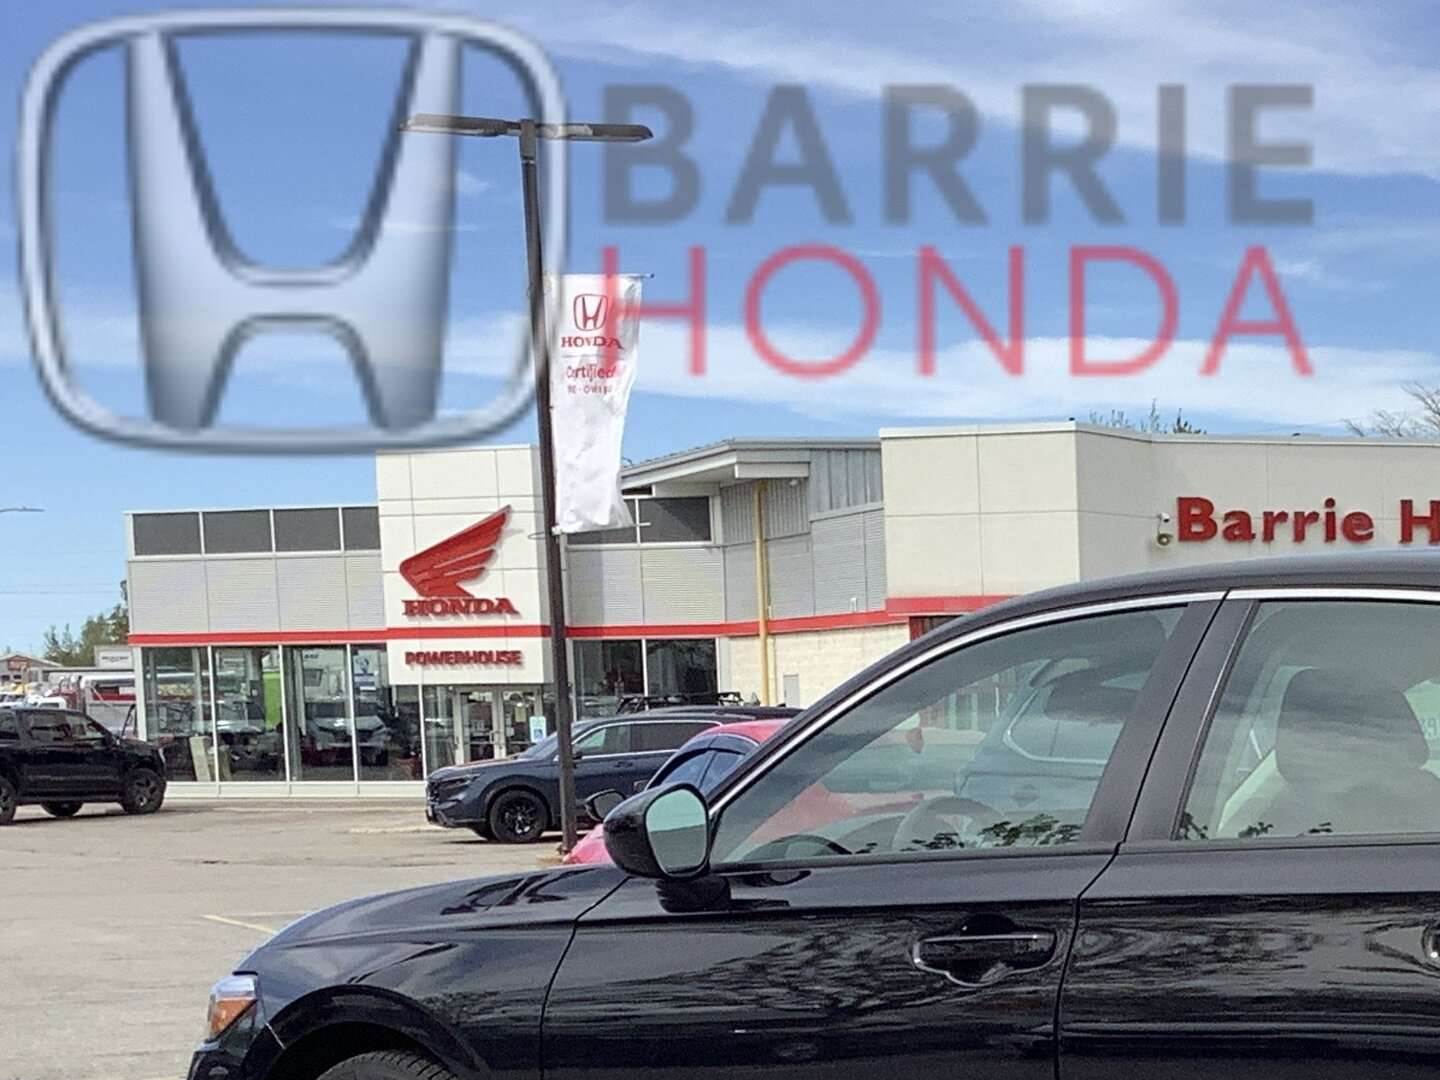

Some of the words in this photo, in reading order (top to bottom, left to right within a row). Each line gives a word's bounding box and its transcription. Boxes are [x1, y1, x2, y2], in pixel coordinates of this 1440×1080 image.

[1177, 496, 1374, 543] Barrie
[401, 598, 519, 616] HONDA
[405, 650, 522, 666] POWERHOUSE
